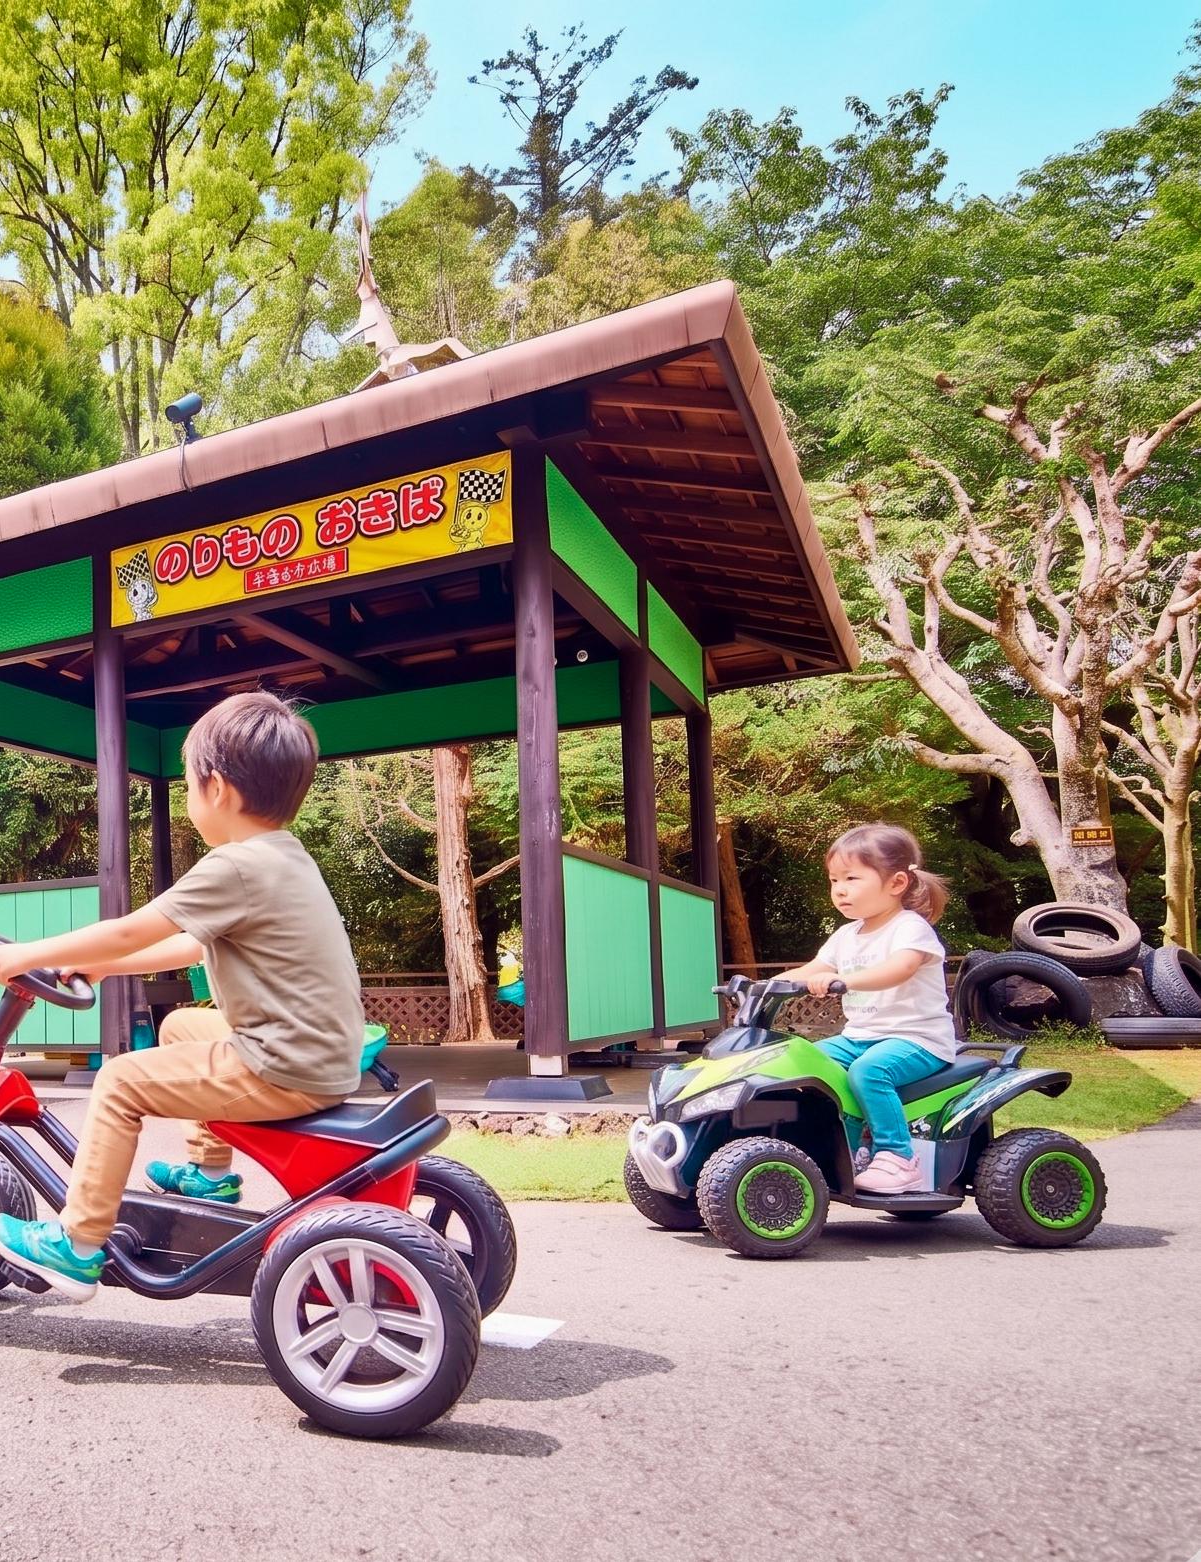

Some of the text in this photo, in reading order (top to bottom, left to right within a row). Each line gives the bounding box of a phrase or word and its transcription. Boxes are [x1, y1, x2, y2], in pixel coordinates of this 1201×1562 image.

[155, 516, 300, 582] のりもの
[317, 476, 445, 545] おきば
